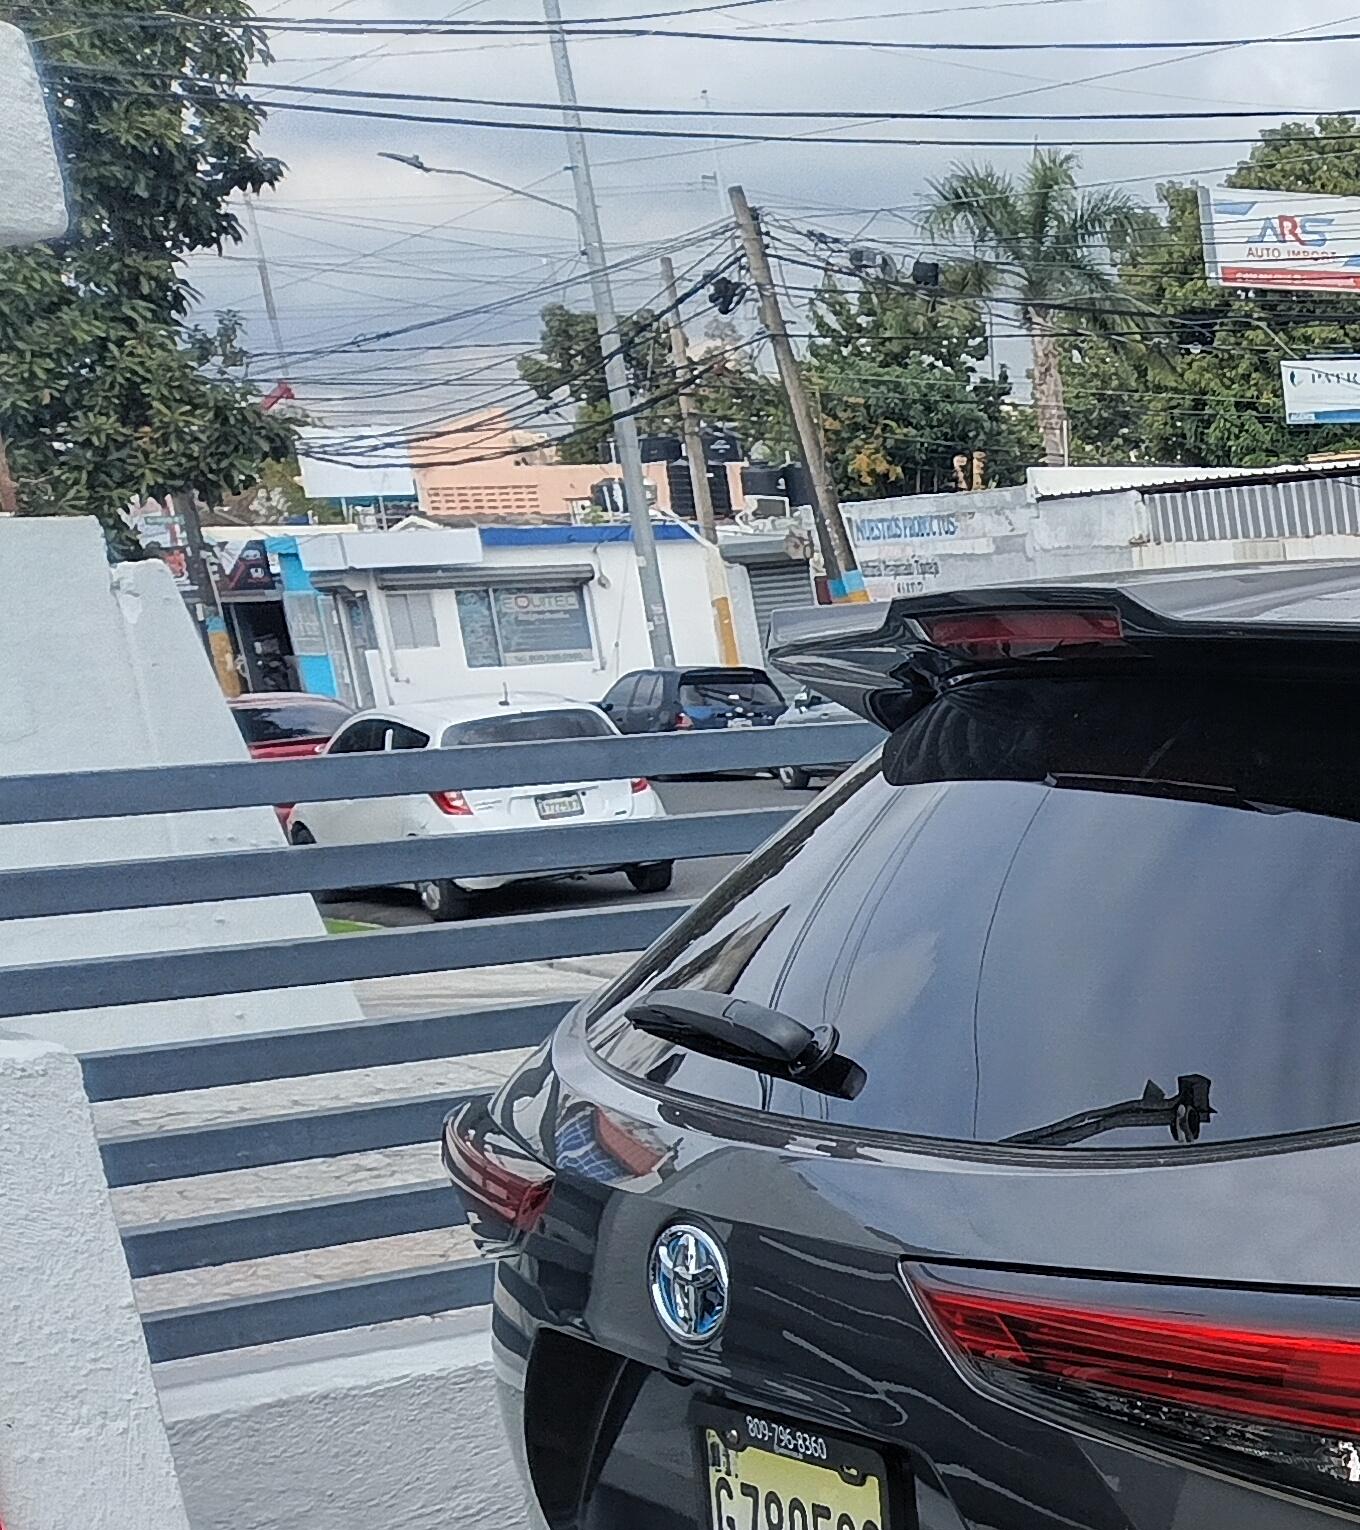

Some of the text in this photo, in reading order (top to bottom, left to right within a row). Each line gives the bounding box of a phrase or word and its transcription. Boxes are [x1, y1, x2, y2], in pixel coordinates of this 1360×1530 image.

[1247, 215, 1335, 247] ARS
[1247, 248, 1281, 258] AUTO
[746, 1416, 826, 1459] 809-796-8360
